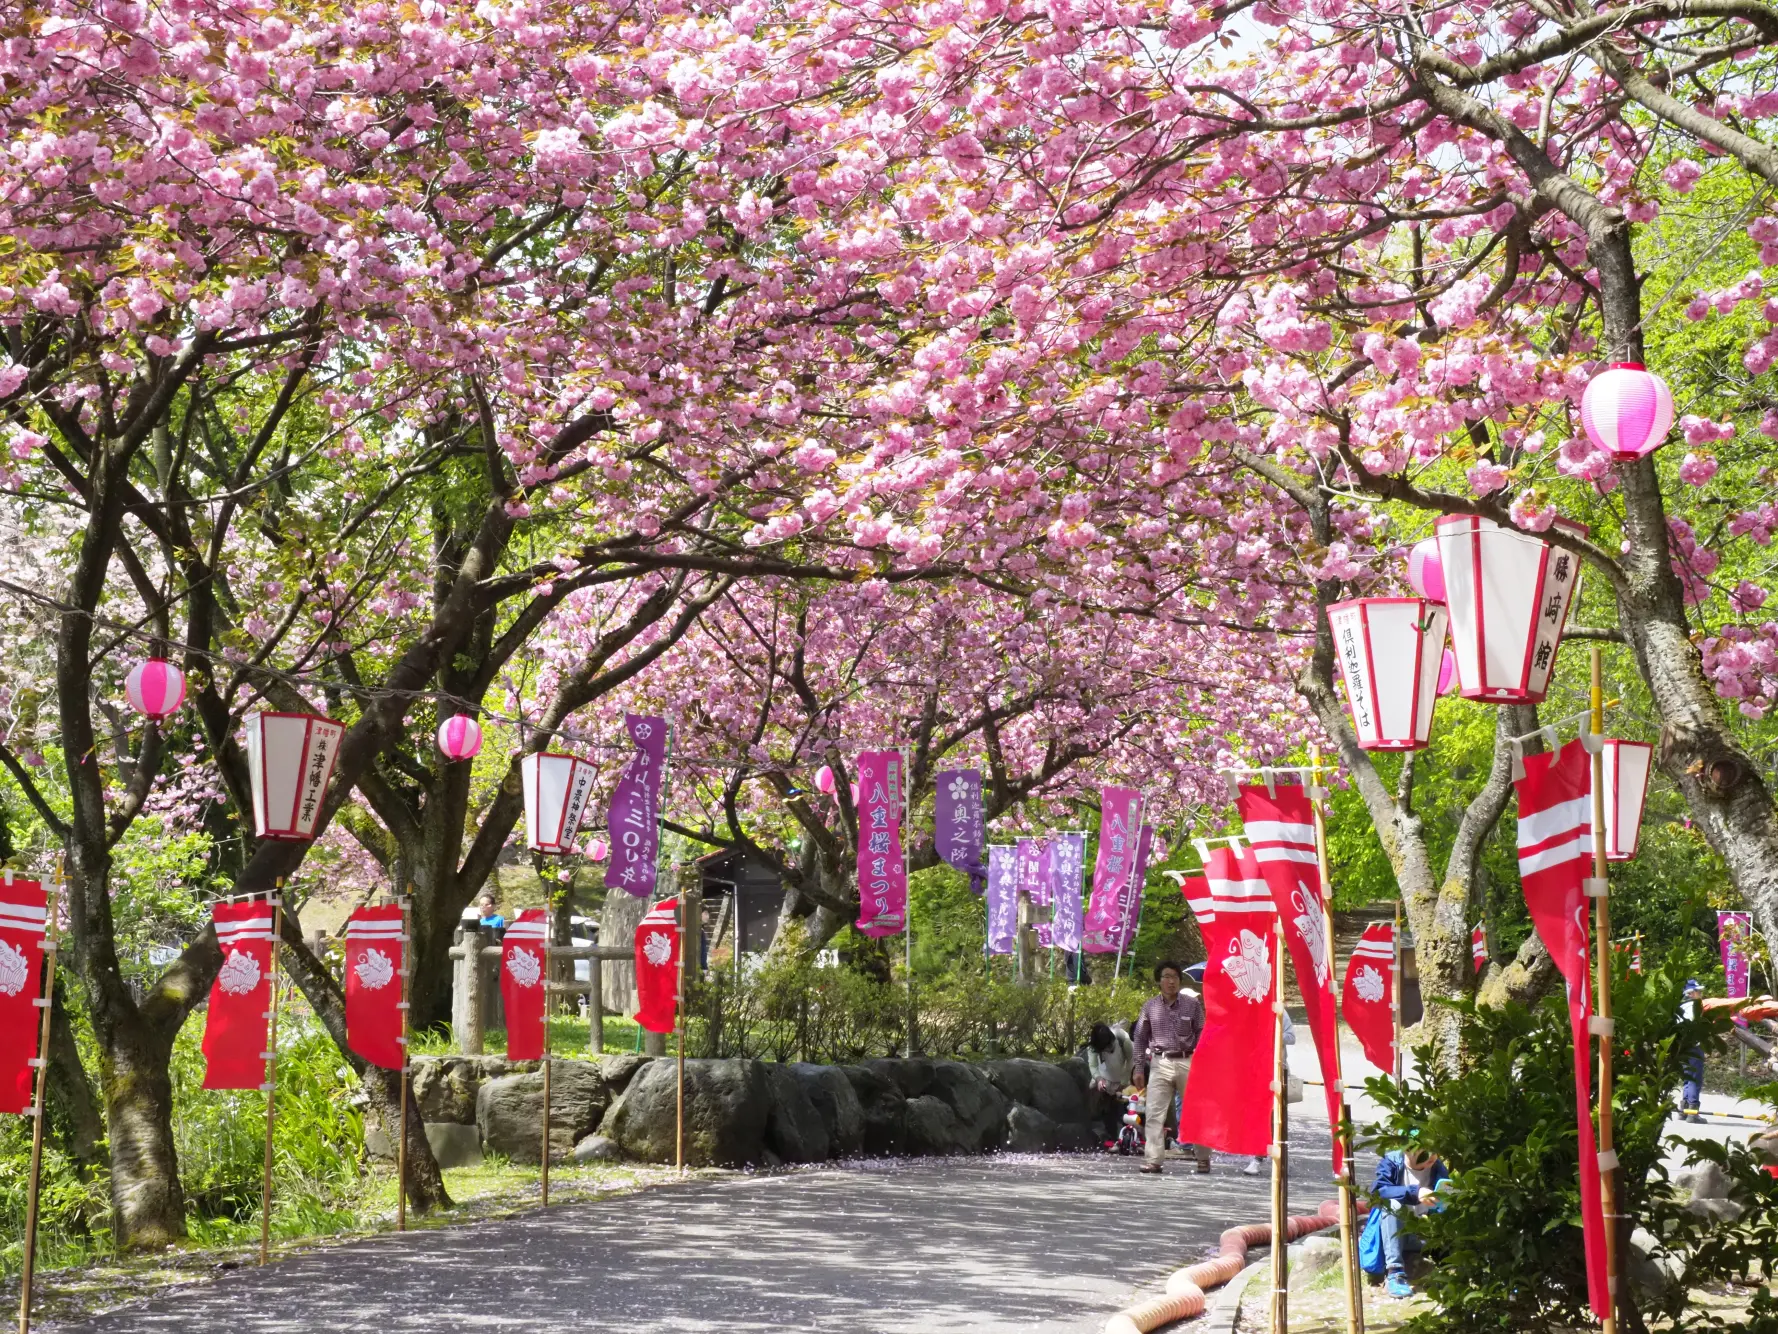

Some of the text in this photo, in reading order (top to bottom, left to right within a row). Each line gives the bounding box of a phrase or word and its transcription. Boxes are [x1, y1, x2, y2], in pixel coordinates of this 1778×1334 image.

[868, 782, 891, 916] 八重桜まつり
[951, 803, 971, 862] 奥之院
